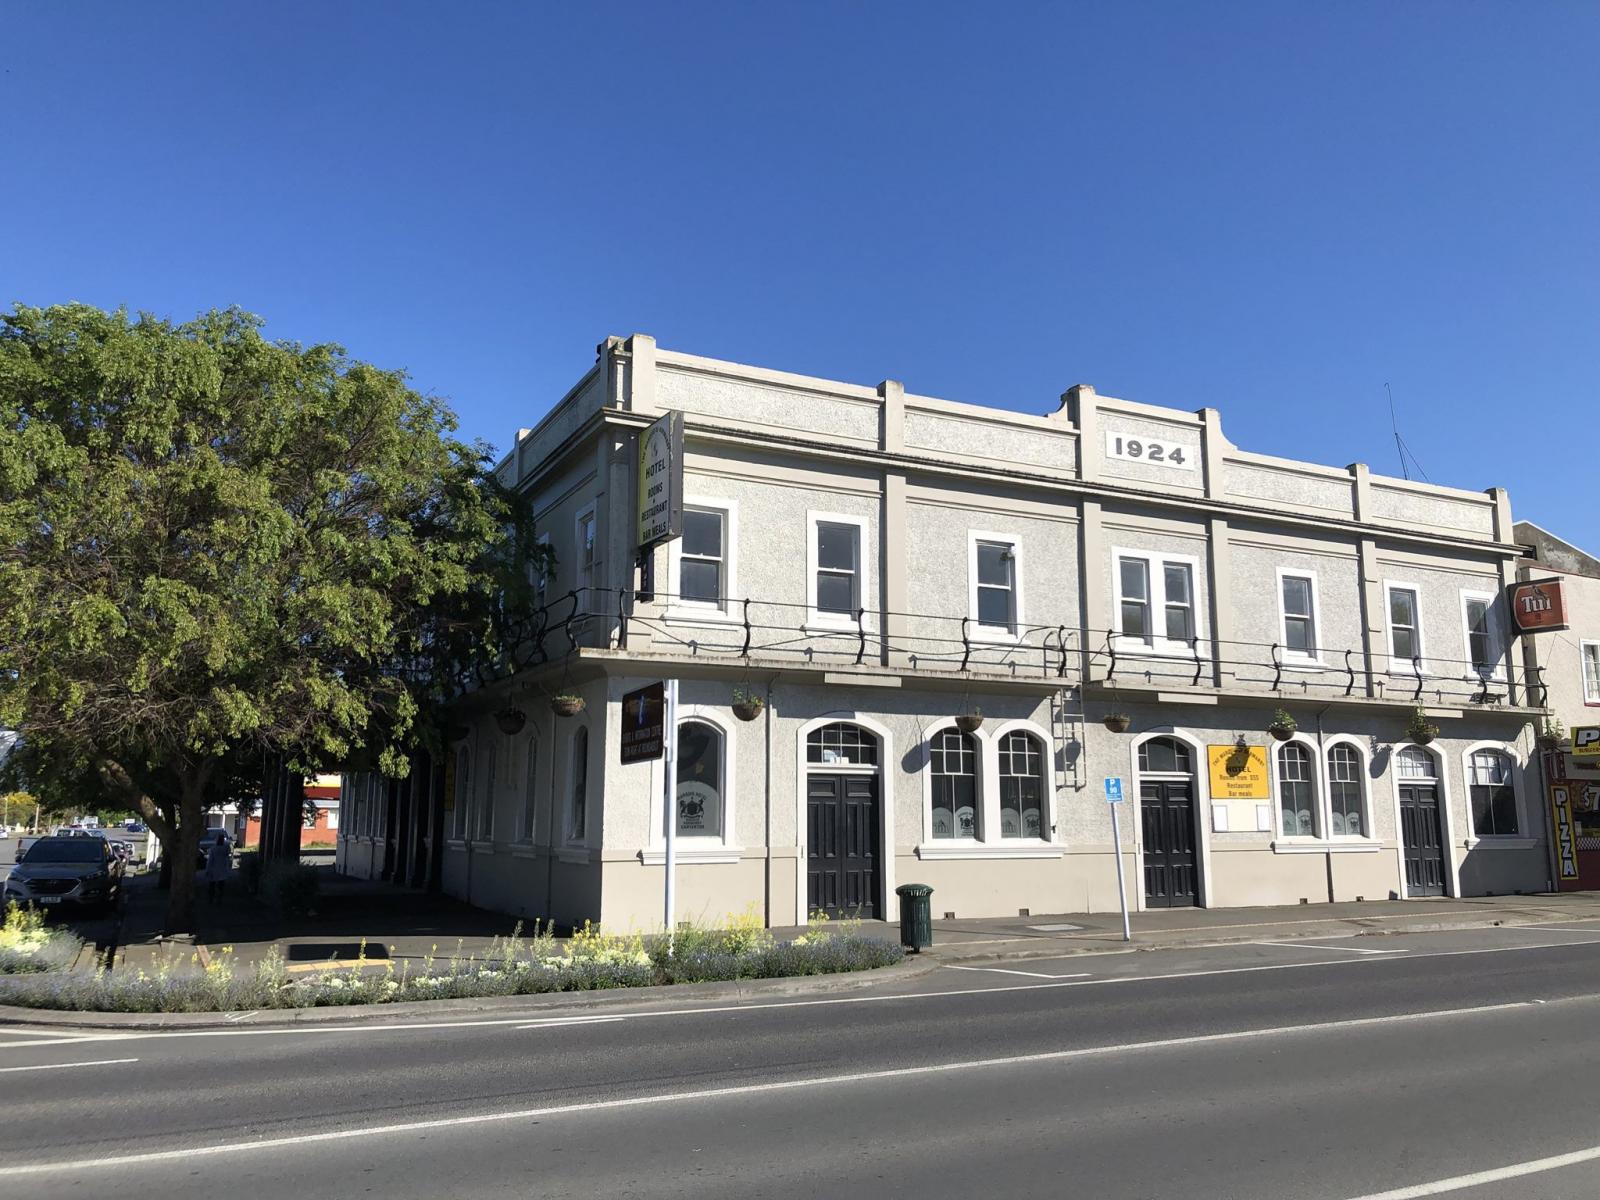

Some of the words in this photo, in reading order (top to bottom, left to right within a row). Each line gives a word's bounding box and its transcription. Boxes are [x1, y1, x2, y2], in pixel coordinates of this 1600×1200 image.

[1115, 437, 1186, 465] 1924
[645, 459, 666, 479] HOTEL
[647, 482, 663, 498] ROOMS
[641, 500, 668, 522] RESTAURANT
[642, 528, 651, 542] BAR
[651, 523, 666, 537] MEALS
[1554, 788, 1576, 876] PIZZA
